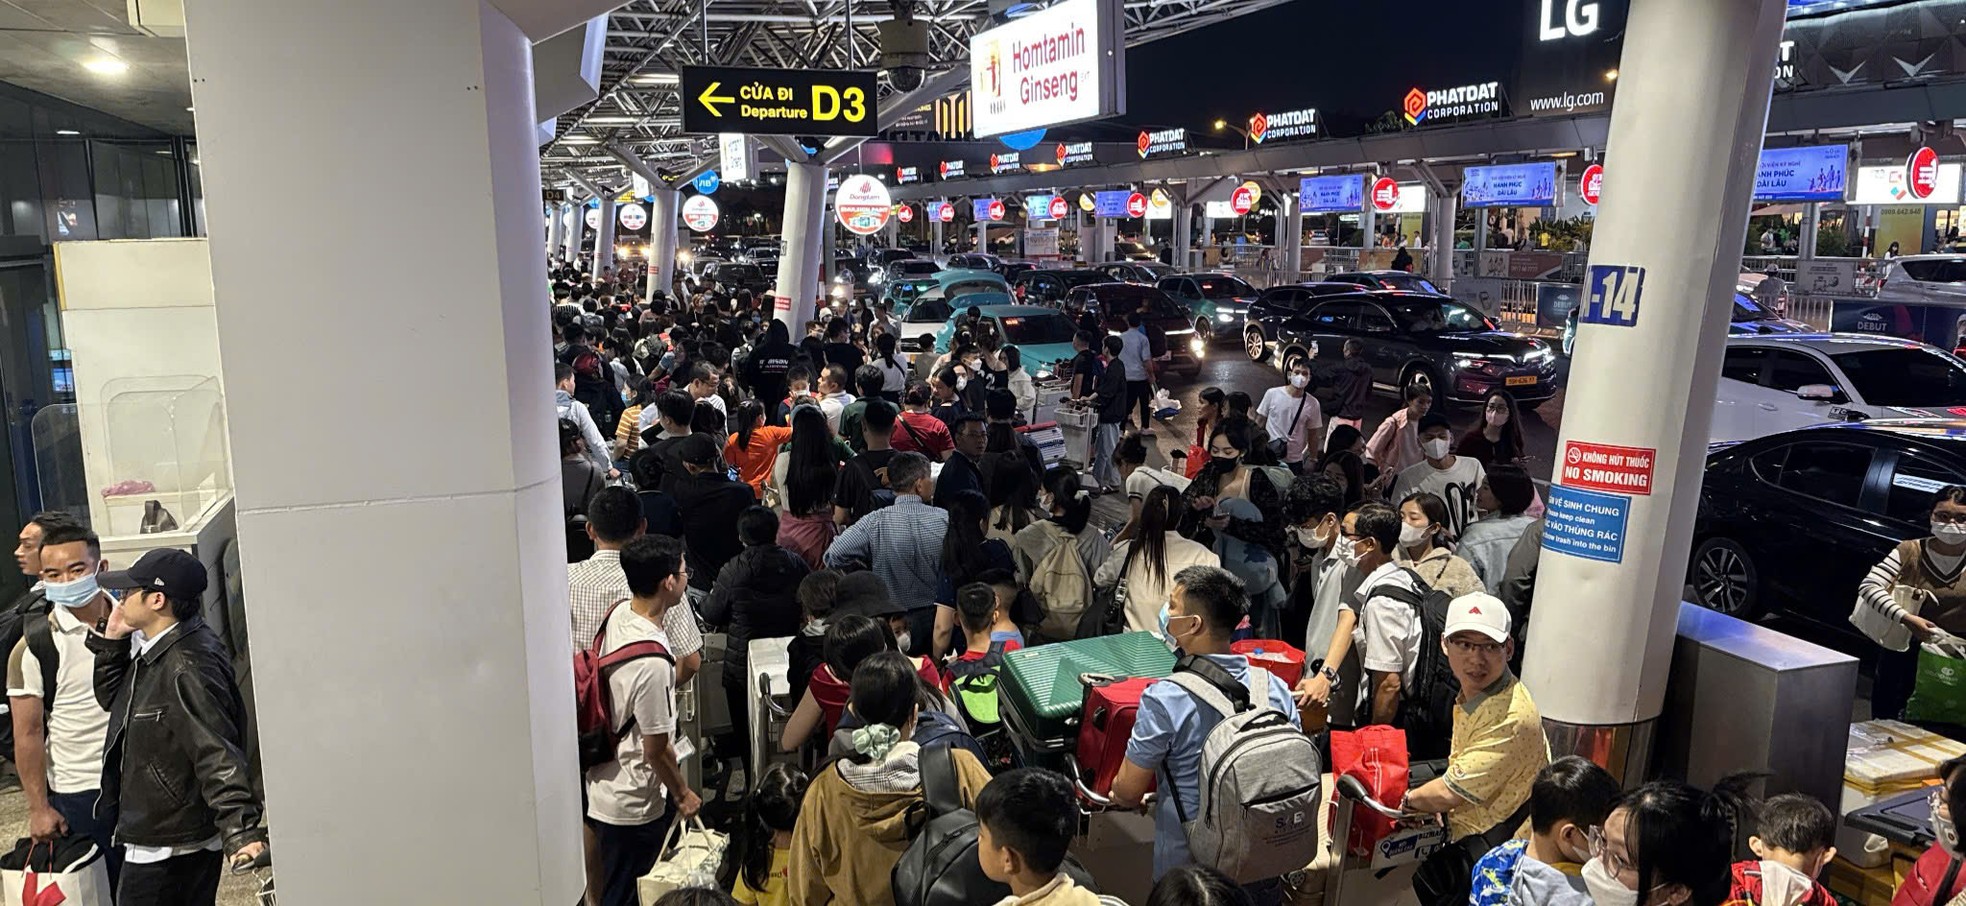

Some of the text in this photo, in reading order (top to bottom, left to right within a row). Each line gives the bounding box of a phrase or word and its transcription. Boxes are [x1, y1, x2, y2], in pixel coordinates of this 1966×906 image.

[1539, 0, 1599, 41] LG
[1013, 22, 1085, 73] Homtamin
[740, 81, 793, 101] CỬA ĐI
[1020, 70, 1078, 105] Ginseng
[1426, 82, 1498, 107] PHATDAT
[811, 85, 866, 122] D3
[1427, 101, 1498, 120] CORPORATION
[1530, 91, 1604, 112] www.lg.com
[741, 104, 808, 120] Departure
[1266, 108, 1316, 129] PHATDAT
[1149, 128, 1185, 144] PHATDAT
[1267, 124, 1316, 139] CORPORATION
[1065, 142, 1093, 154] PHATDAT
[1149, 140, 1186, 154] CORPORATION
[1857, 321, 1887, 331] DEBUT
[1582, 451, 1650, 469] KHÔNG HÚT THUỐC
[1565, 466, 1648, 487] NO SMOKING
[1563, 499, 1583, 511] SINH
[1584, 503, 1620, 517] CHUNG
[1559, 511, 1574, 522] keep
[1575, 515, 1595, 525] clean
[1551, 519, 1563, 532] VÀO
[1564, 524, 1595, 538] THÙNG
[1597, 529, 1618, 541] RÁC
[1572, 537, 1588, 549] into
[1588, 540, 1602, 551] the
[1603, 541, 1617, 553] bin
